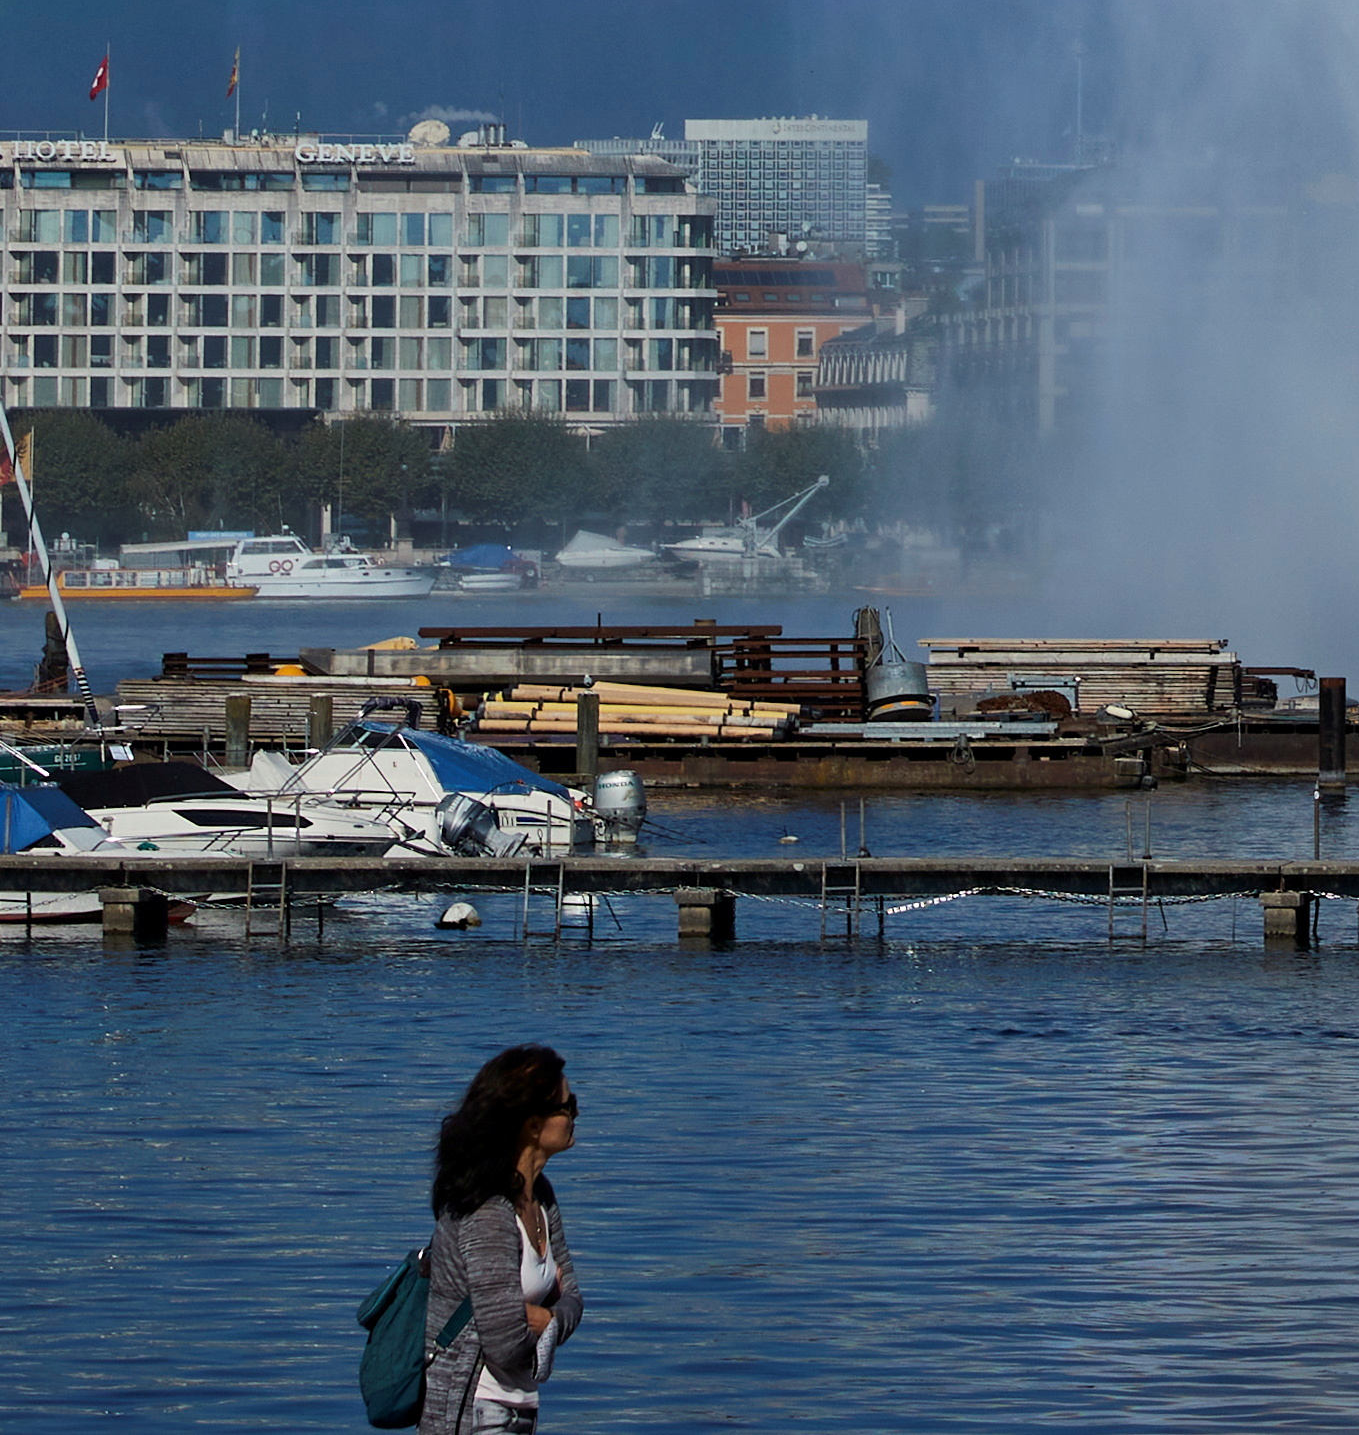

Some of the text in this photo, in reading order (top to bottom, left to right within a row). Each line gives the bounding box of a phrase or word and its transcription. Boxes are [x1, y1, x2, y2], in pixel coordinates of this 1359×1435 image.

[12, 139, 111, 160] HOTEL
[295, 143, 415, 163] GENEVE
[598, 780, 634, 789] HONDA
